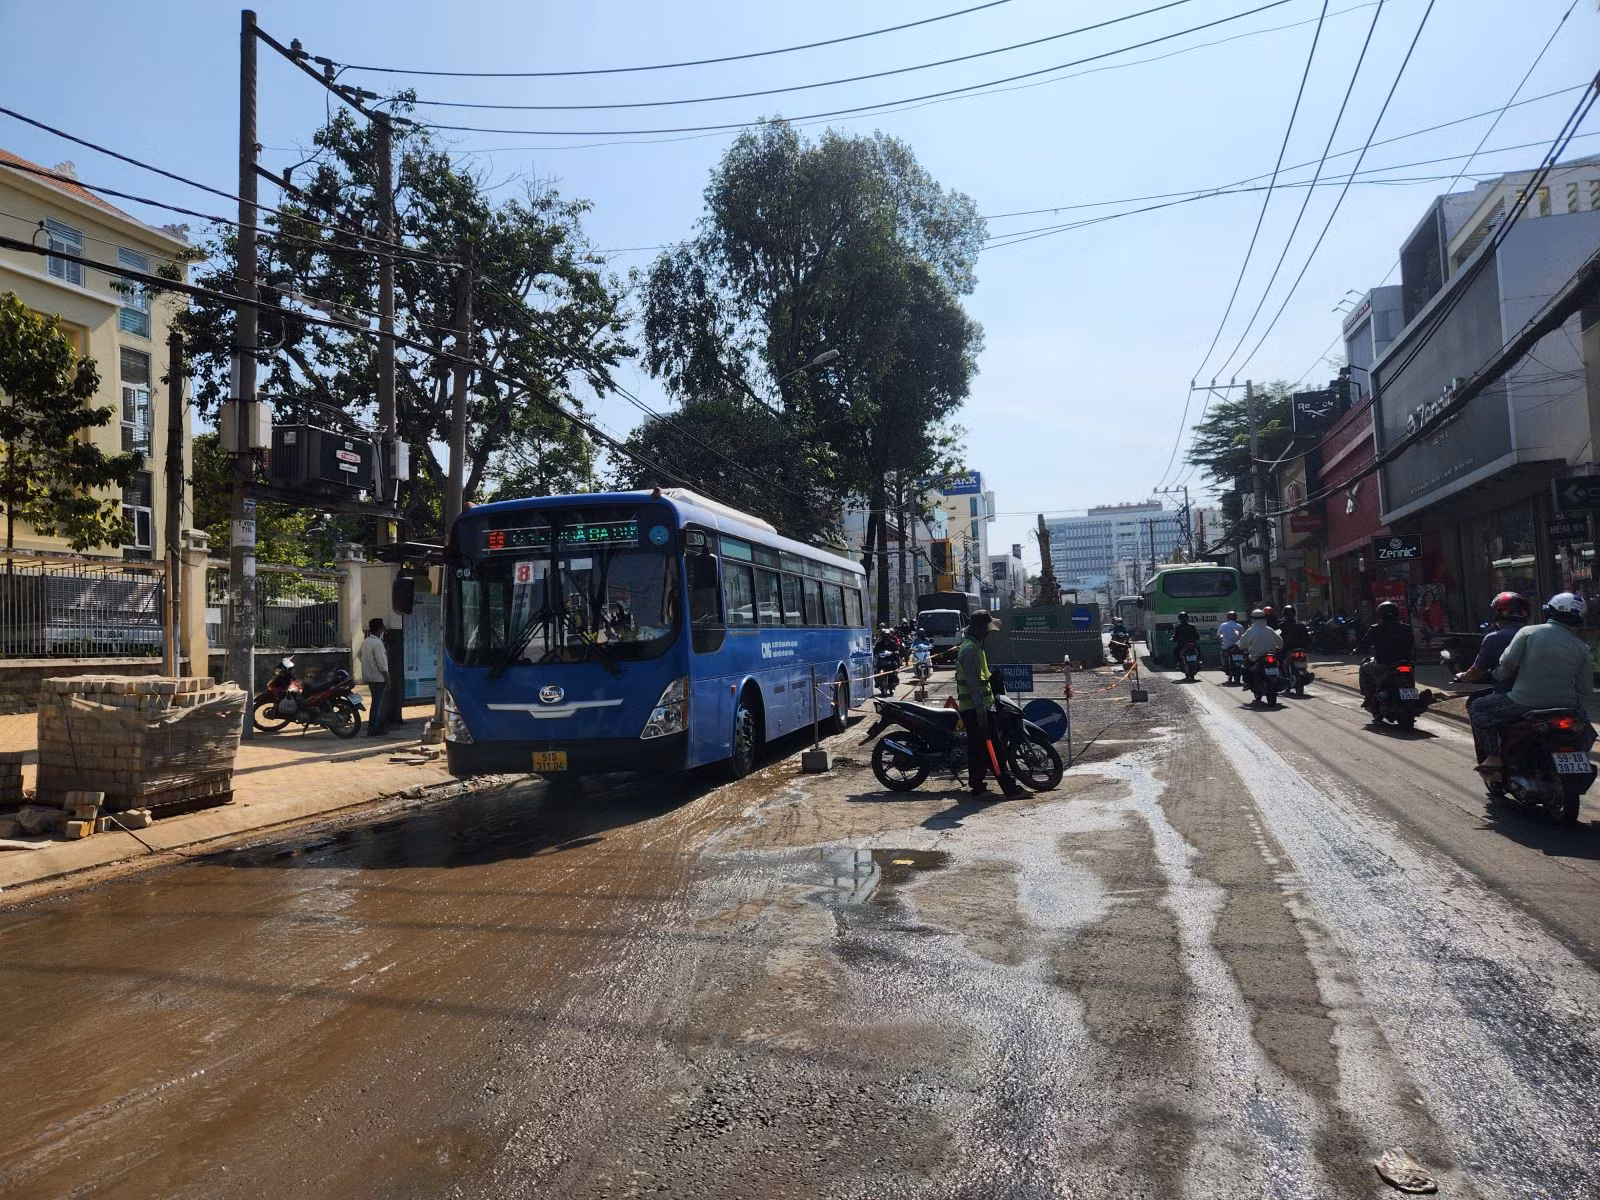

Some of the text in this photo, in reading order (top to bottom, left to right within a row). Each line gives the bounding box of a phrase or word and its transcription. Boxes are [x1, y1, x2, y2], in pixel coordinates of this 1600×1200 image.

[1379, 547, 1414, 559] Zennic
[517, 564, 530, 583] 8
[1557, 762, 1591, 773] 387.42
